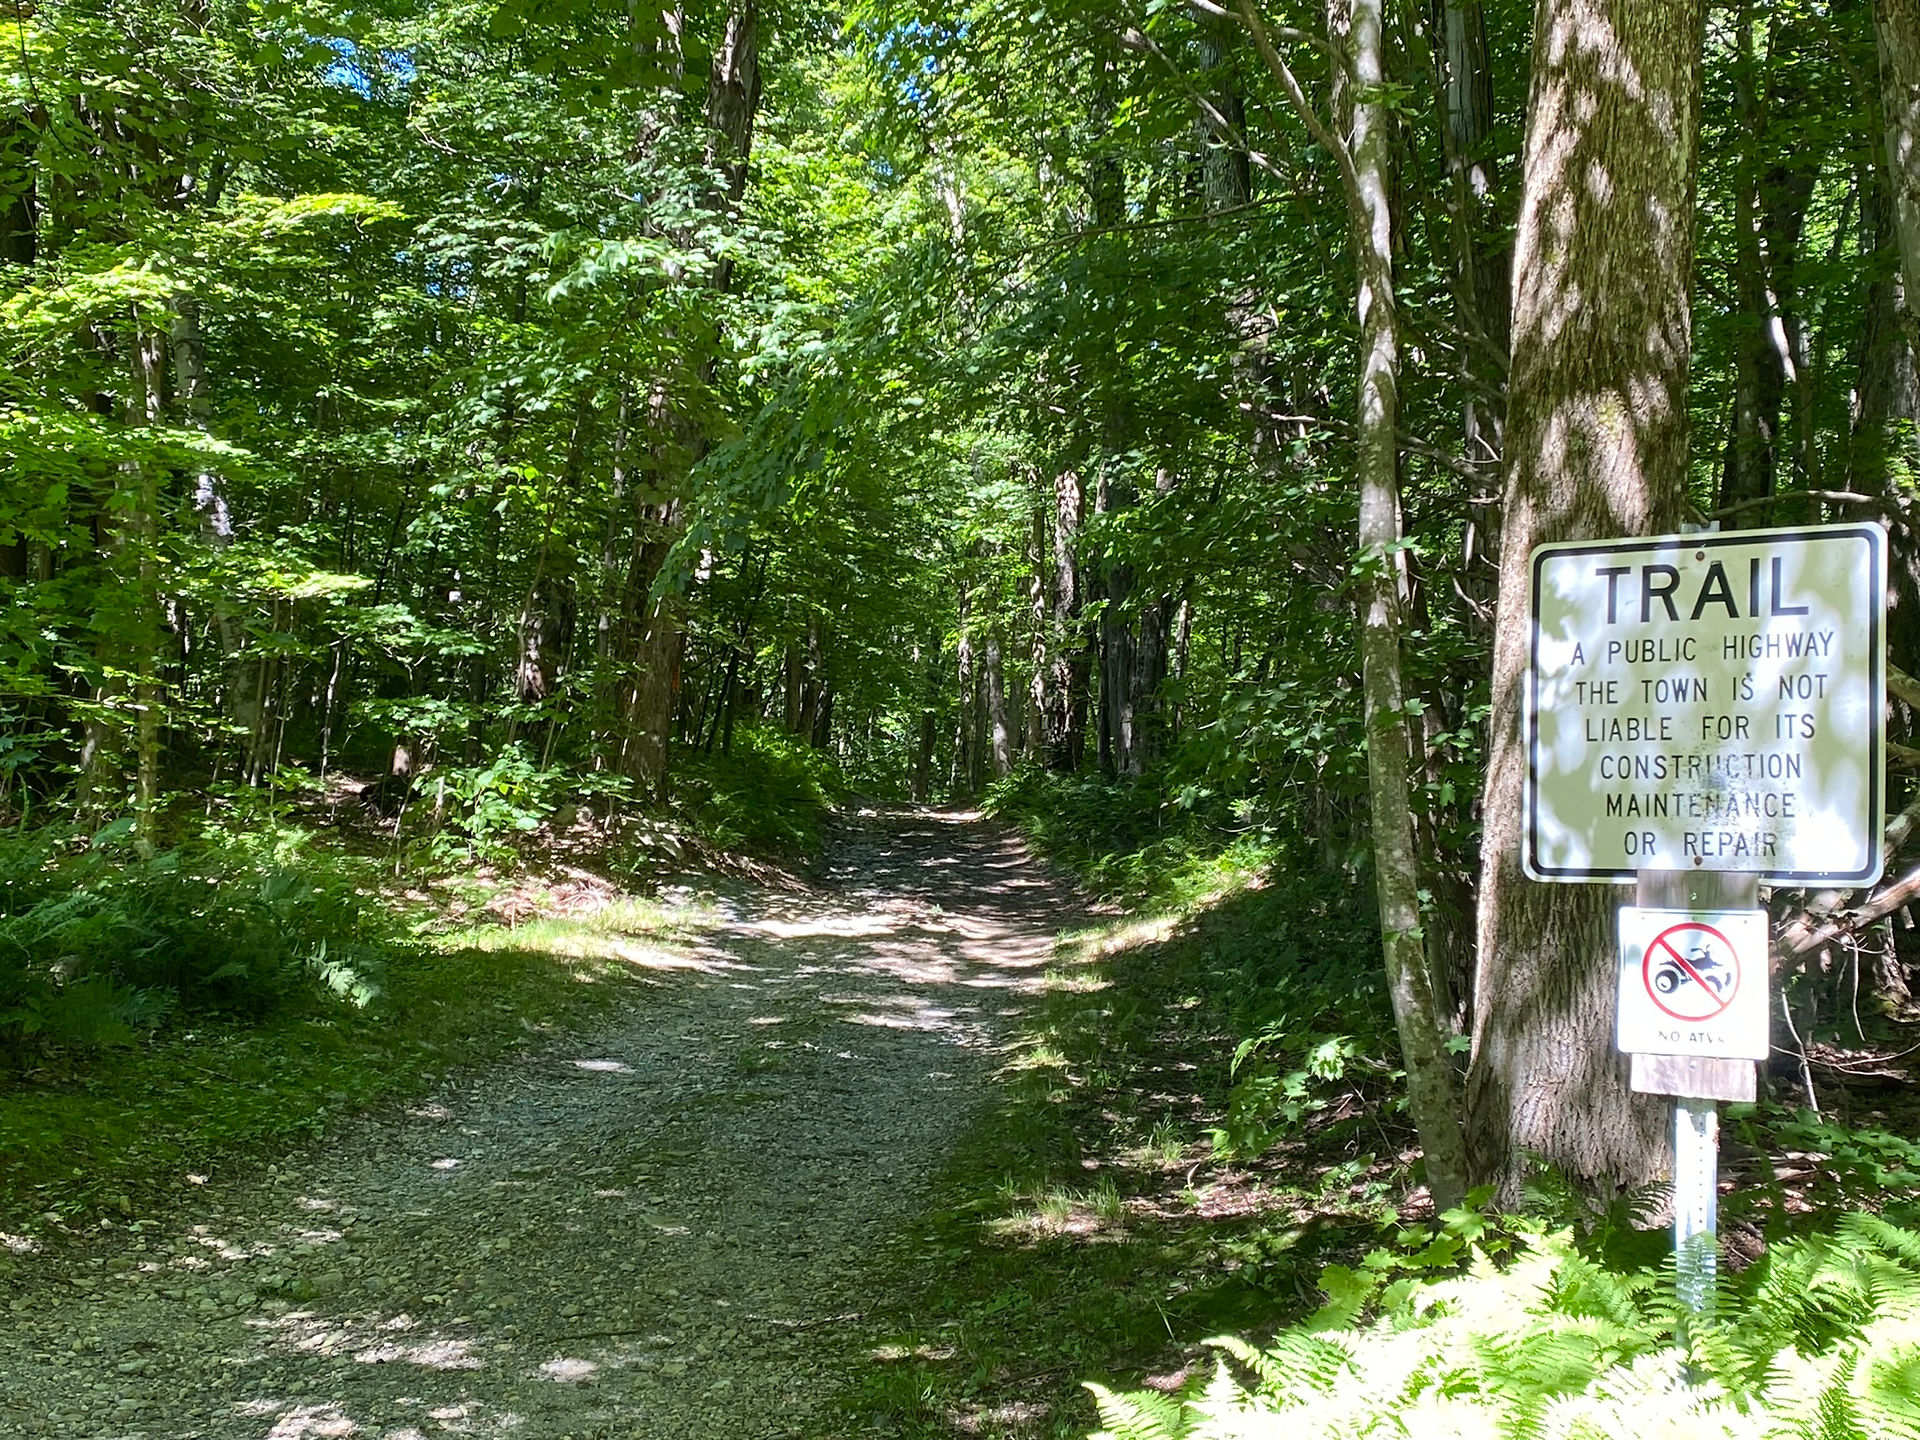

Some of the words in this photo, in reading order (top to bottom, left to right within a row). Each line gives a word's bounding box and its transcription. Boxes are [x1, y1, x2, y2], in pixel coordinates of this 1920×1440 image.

[1596, 557, 1809, 624] TRAIL
[1570, 642, 1585, 666] A
[1607, 637, 1697, 664] PUBLIC
[1723, 630, 1834, 660] HIGHWAY
[1576, 680, 1619, 705] THE
[1641, 678, 1708, 703] TOWN
[1733, 677, 1754, 701] IS
[1779, 674, 1828, 699] NOT
[1585, 716, 1673, 742] LIABLE
[1702, 715, 1749, 740] FOR
[1776, 713, 1816, 739] ITS
[1606, 792, 1796, 818] MAINTENANCE
[1624, 831, 1656, 856] OR
[1683, 832, 1778, 857] REPAIR
[1659, 1031, 1680, 1042] NO
